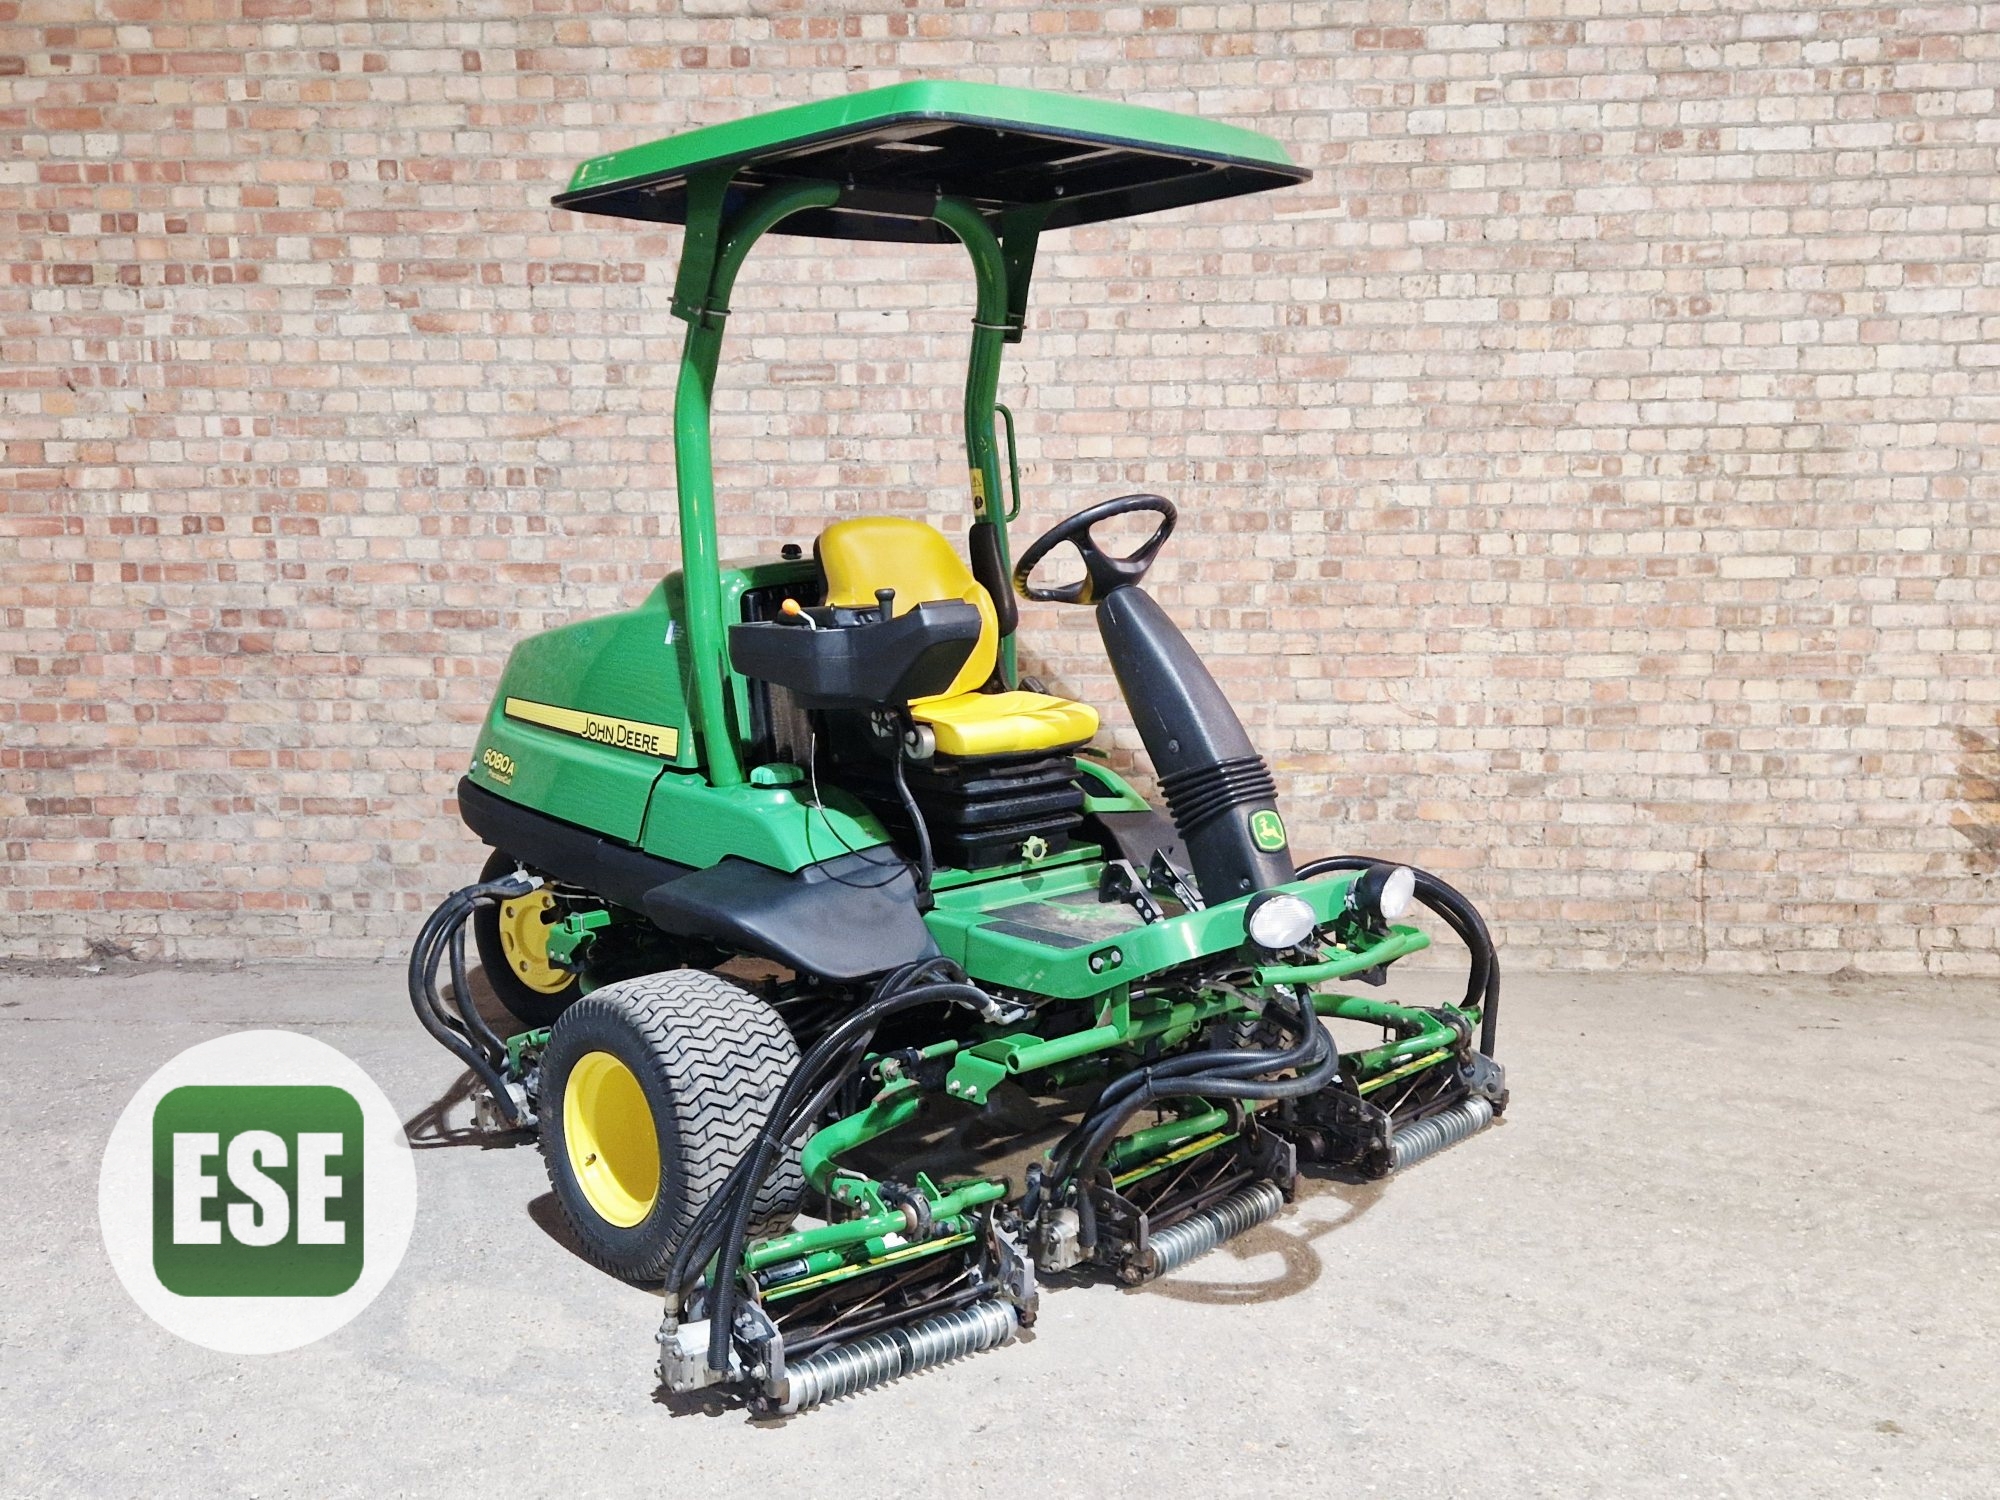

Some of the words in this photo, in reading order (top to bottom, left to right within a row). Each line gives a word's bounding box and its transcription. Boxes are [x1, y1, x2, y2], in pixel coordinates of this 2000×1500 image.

[581, 717, 614, 741] JOHN
[616, 724, 659, 752] DEERE
[483, 748, 515, 776] 6080A
